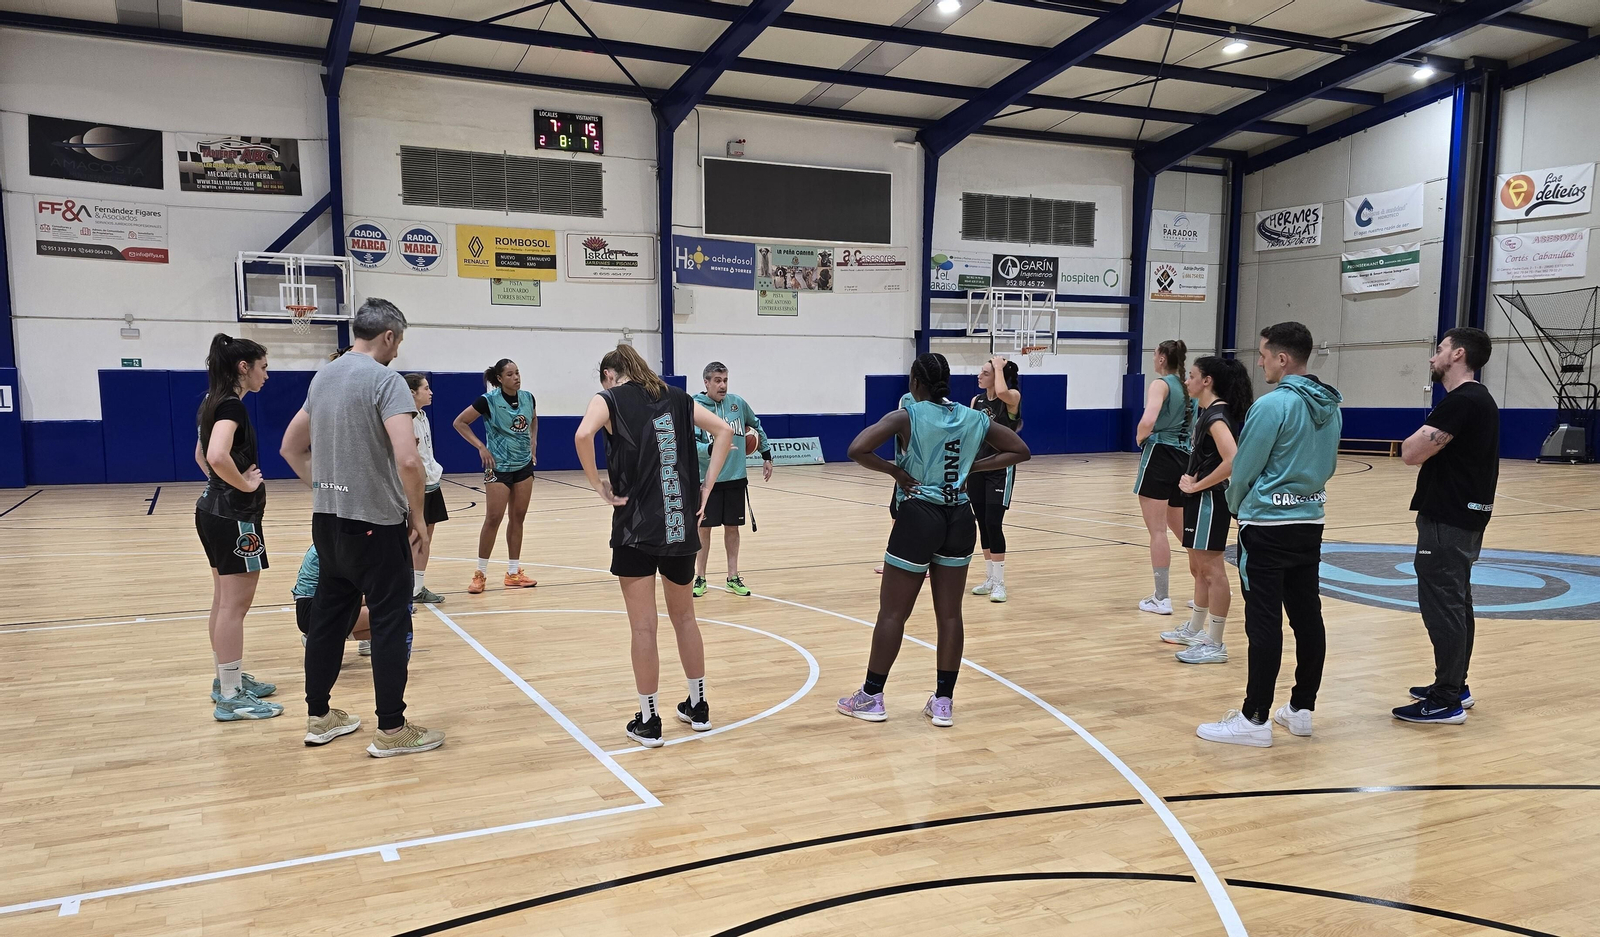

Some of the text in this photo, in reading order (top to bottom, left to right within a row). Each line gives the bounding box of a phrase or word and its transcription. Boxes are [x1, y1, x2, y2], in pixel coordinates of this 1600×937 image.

[550, 120, 557, 132] 7
[585, 123, 596, 136] 15
[540, 135, 546, 145] 2
[594, 140, 599, 150] 2
[202, 148, 273, 162] TALLERES ABC
[50, 158, 144, 176] AMACOSTA
[1544, 172, 1563, 186] Las
[1536, 183, 1587, 201] delicias
[95, 206, 161, 218] Fernández Figares
[102, 213, 138, 221] Asociados
[1270, 207, 1319, 226] HERMES
[354, 230, 382, 238] RADIO
[407, 234, 433, 242] RADIO
[1163, 229, 1198, 237] PARADOR
[352, 239, 386, 251] MARCA
[495, 237, 550, 248] ROMBOSOL
[1266, 236, 1317, 248] TRANSPORTES
[404, 243, 437, 254] MARCA
[712, 254, 752, 266] achedosol
[861, 254, 897, 262] asesores
[1533, 250, 1575, 261] Cabanillas
[1020, 258, 1053, 272] GARÍN
[1061, 272, 1099, 284] hospiten
[767, 442, 819, 451] TEPONA
[653, 412, 685, 544] ESTEPONA
